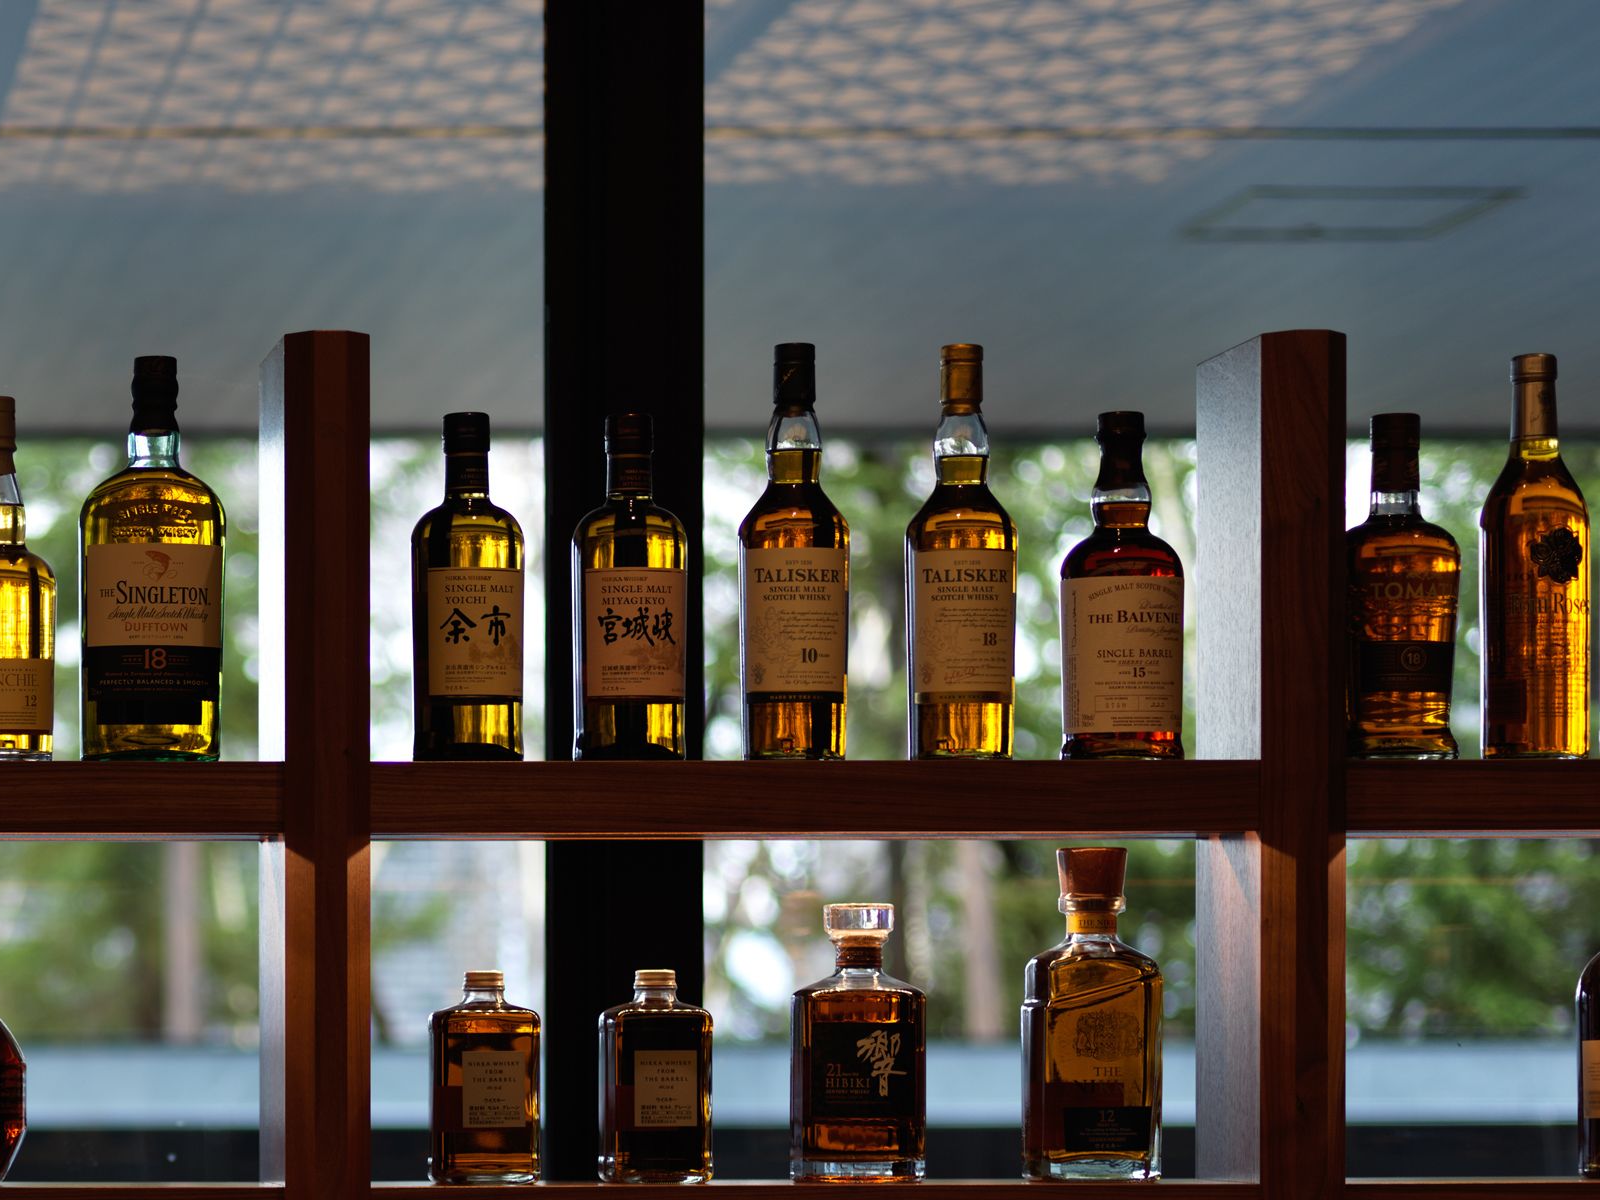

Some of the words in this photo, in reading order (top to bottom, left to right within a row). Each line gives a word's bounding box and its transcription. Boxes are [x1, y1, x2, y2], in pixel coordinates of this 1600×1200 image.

[754, 567, 841, 583] TALISKER
[921, 567, 1008, 584] TALISKER
[100, 588, 115, 598] THE
[116, 580, 208, 606] SINGLETON
[445, 583, 487, 593] SINGLE
[490, 584, 514, 595] MALT
[600, 585, 643, 595] SINGLE
[645, 585, 673, 594] MALT
[1114, 583, 1134, 592] MALT
[1371, 582, 1457, 600] TOMATI
[445, 596, 487, 606] YOICHI
[600, 597, 665, 606] MIYAGIKYO
[930, 594, 966, 602] SCOTCH
[1088, 613, 1113, 624] THE
[1116, 609, 1180, 624] BALVENIE
[124, 621, 188, 632] DUFFTOWN
[440, 604, 512, 646] 余市
[981, 632, 997, 647] 18
[143, 648, 168, 671] 18
[800, 647, 818, 664] 10
[1096, 649, 1135, 658] SINGLE
[1138, 649, 1173, 658] BARREL
[1132, 666, 1146, 678] 15
[24, 695, 38, 707] 12
[825, 1063, 842, 1076] 21
[1093, 1066, 1121, 1077] THE
[824, 1077, 870, 1089] HIBIKI
[1097, 1110, 1115, 1122] 12
